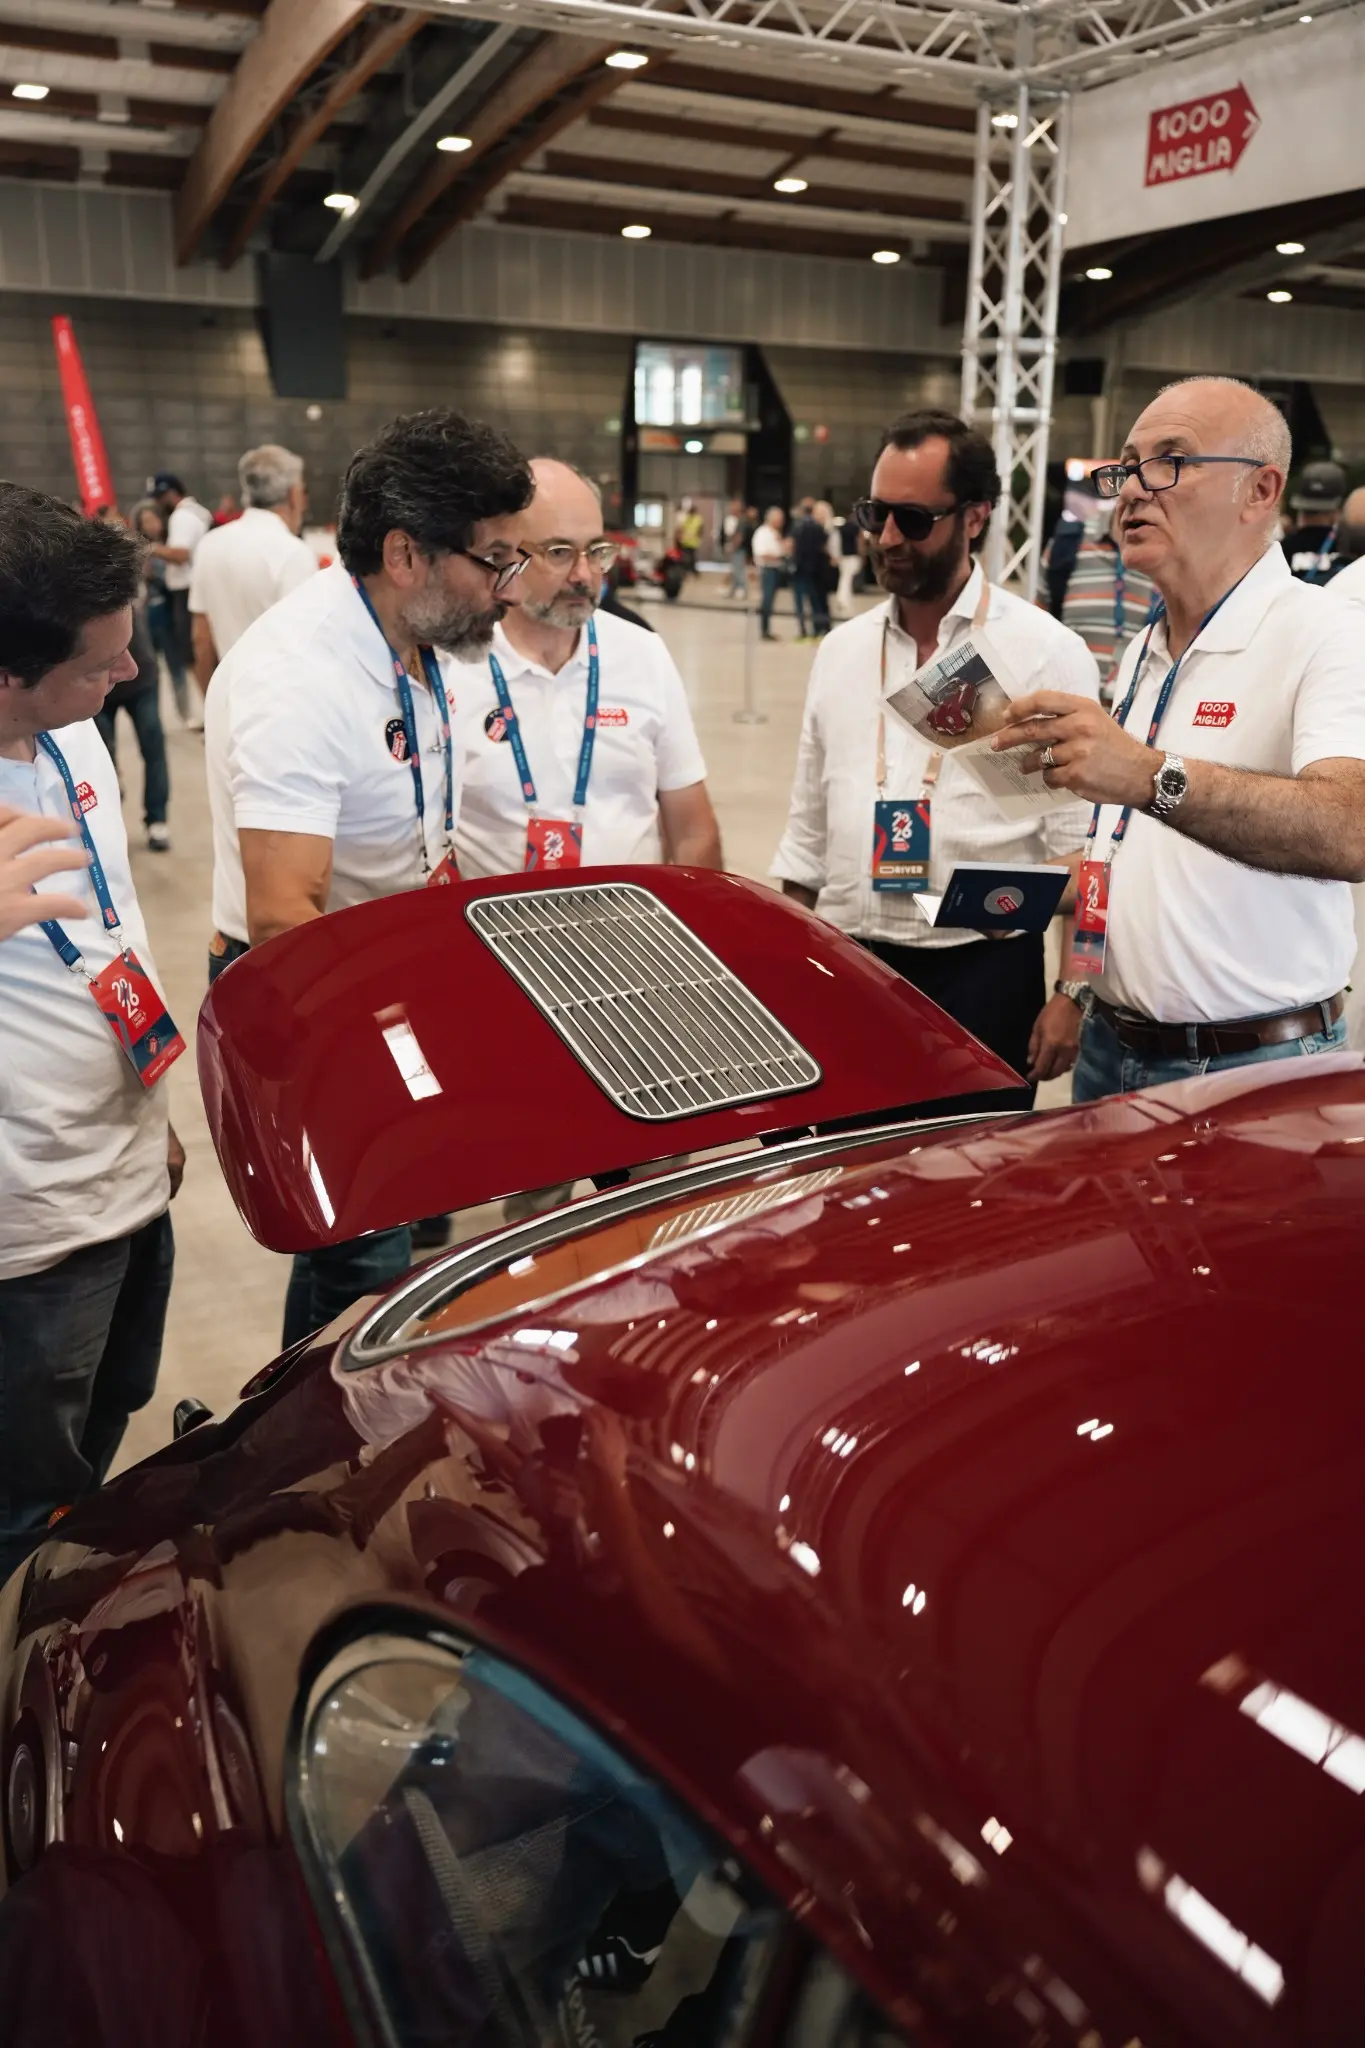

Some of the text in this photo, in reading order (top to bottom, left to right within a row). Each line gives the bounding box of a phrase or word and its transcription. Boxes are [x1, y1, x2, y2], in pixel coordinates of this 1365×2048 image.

[1157, 99, 1231, 141] 1000
[1149, 136, 1232, 180] MIGLIA
[1194, 715, 1227, 726] MIGLIA
[1201, 703, 1229, 713] 1000
